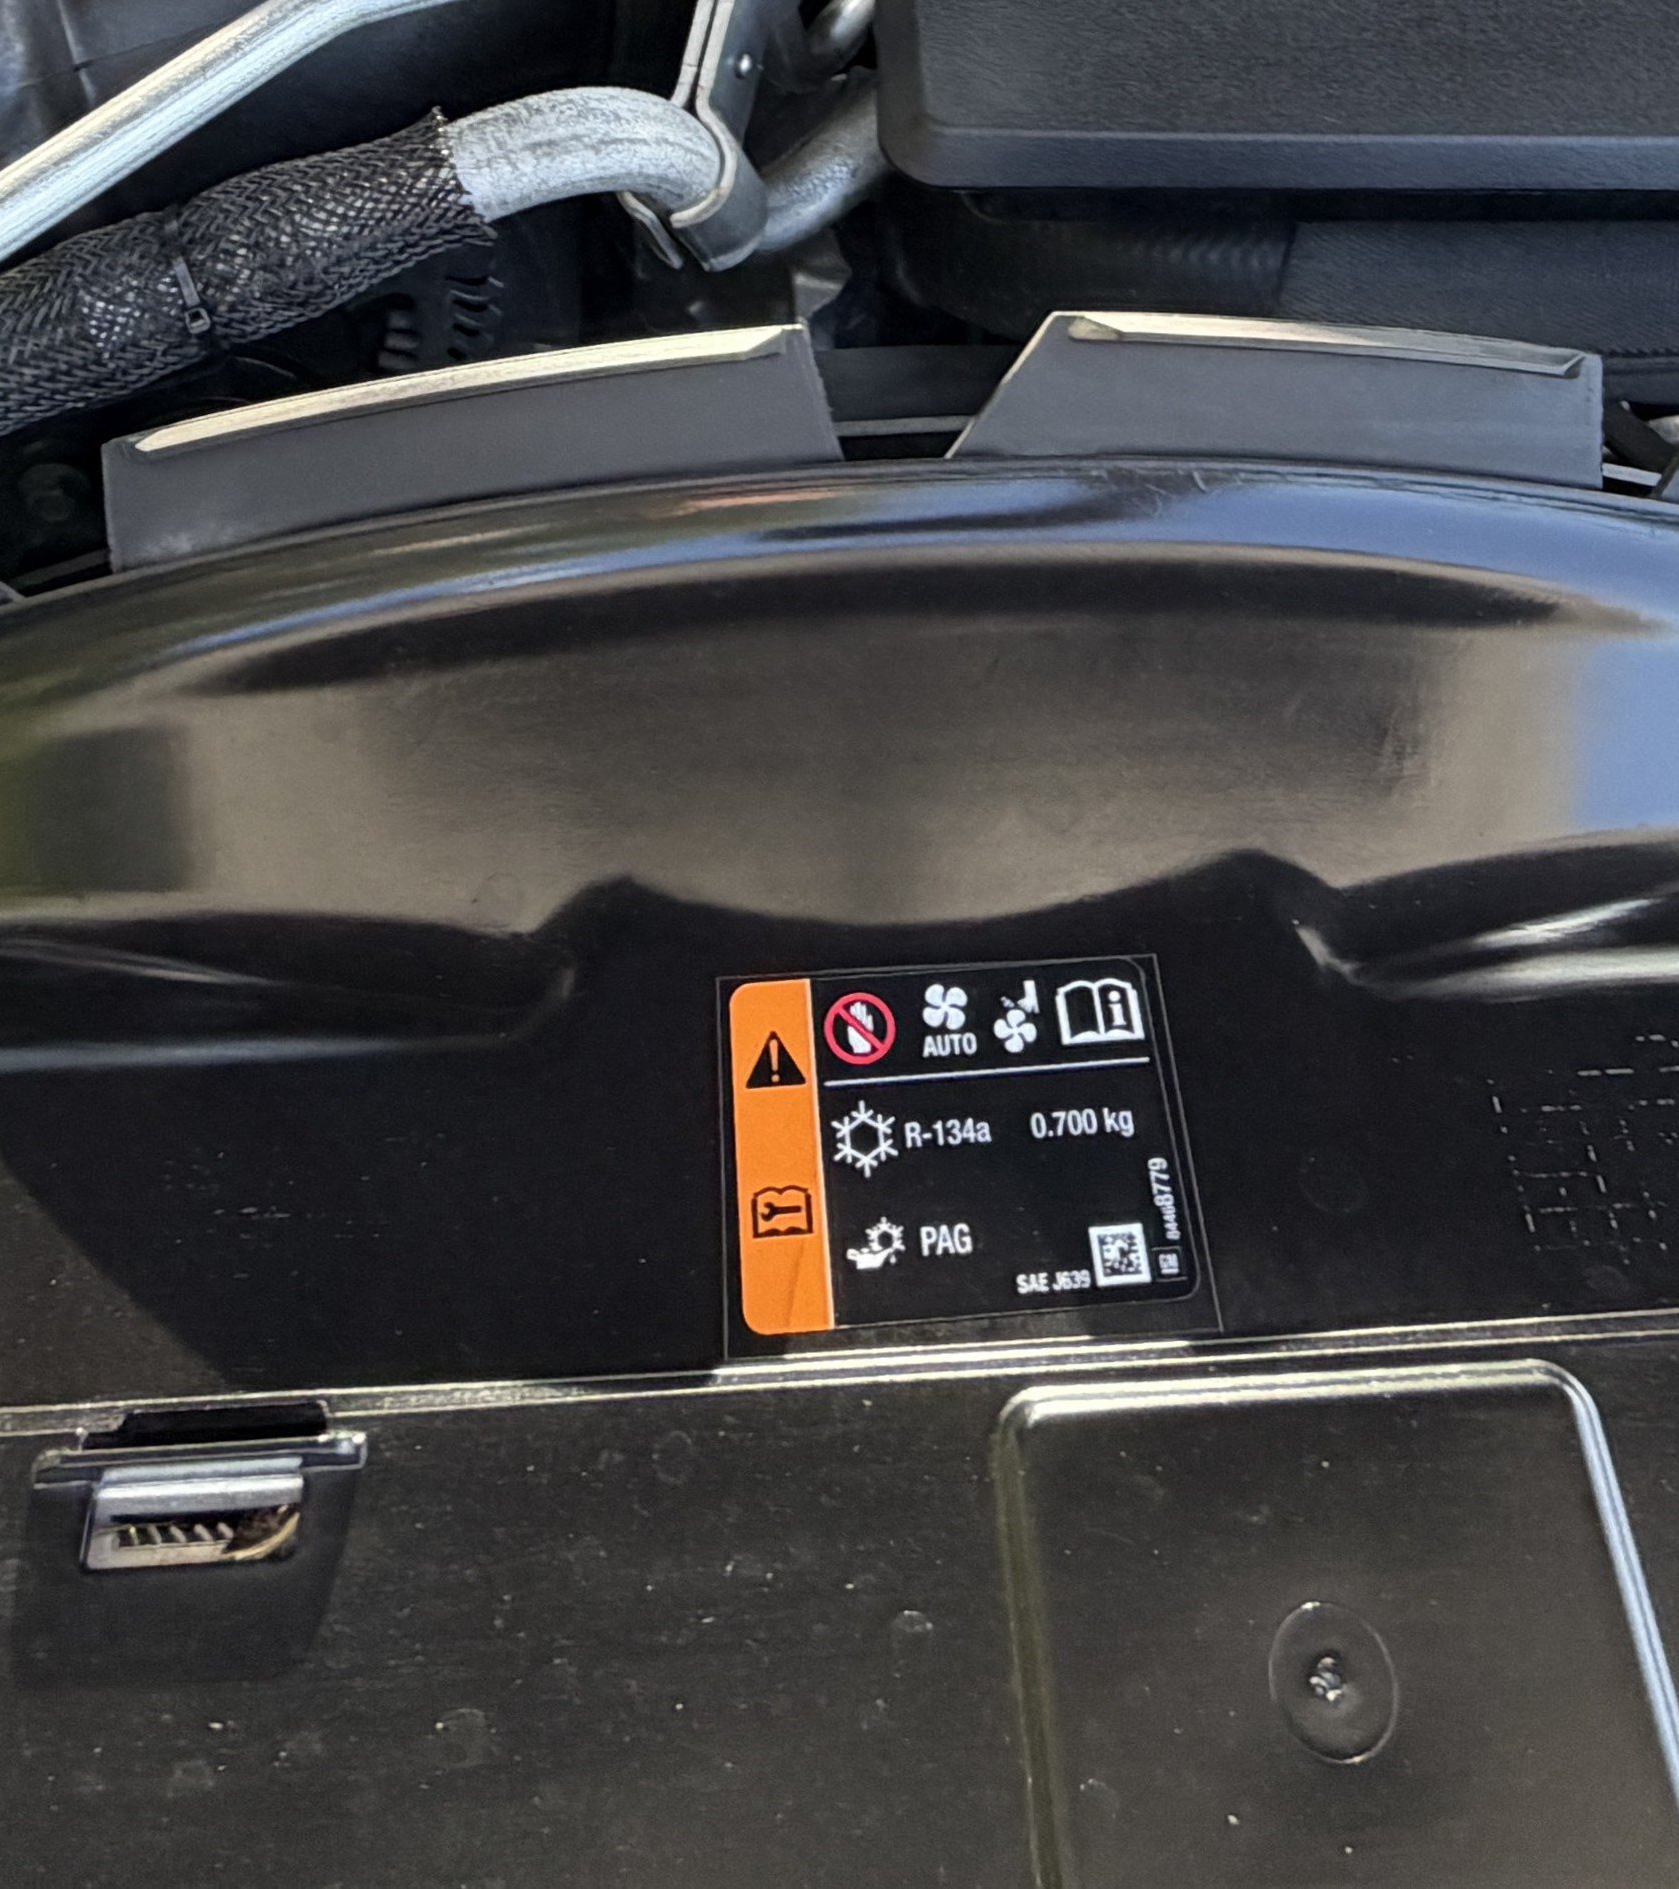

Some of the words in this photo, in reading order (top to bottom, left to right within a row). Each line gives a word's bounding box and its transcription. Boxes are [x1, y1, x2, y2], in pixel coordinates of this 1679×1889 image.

[922, 1031, 978, 1058] AUTO
[904, 1117, 993, 1149] R-134a
[1030, 1110, 1098, 1140] 0.700
[1102, 1107, 1135, 1138] kg
[919, 1222, 975, 1257] PAG
[1016, 1271, 1050, 1295] SAE
[1051, 1268, 1092, 1293] J639
